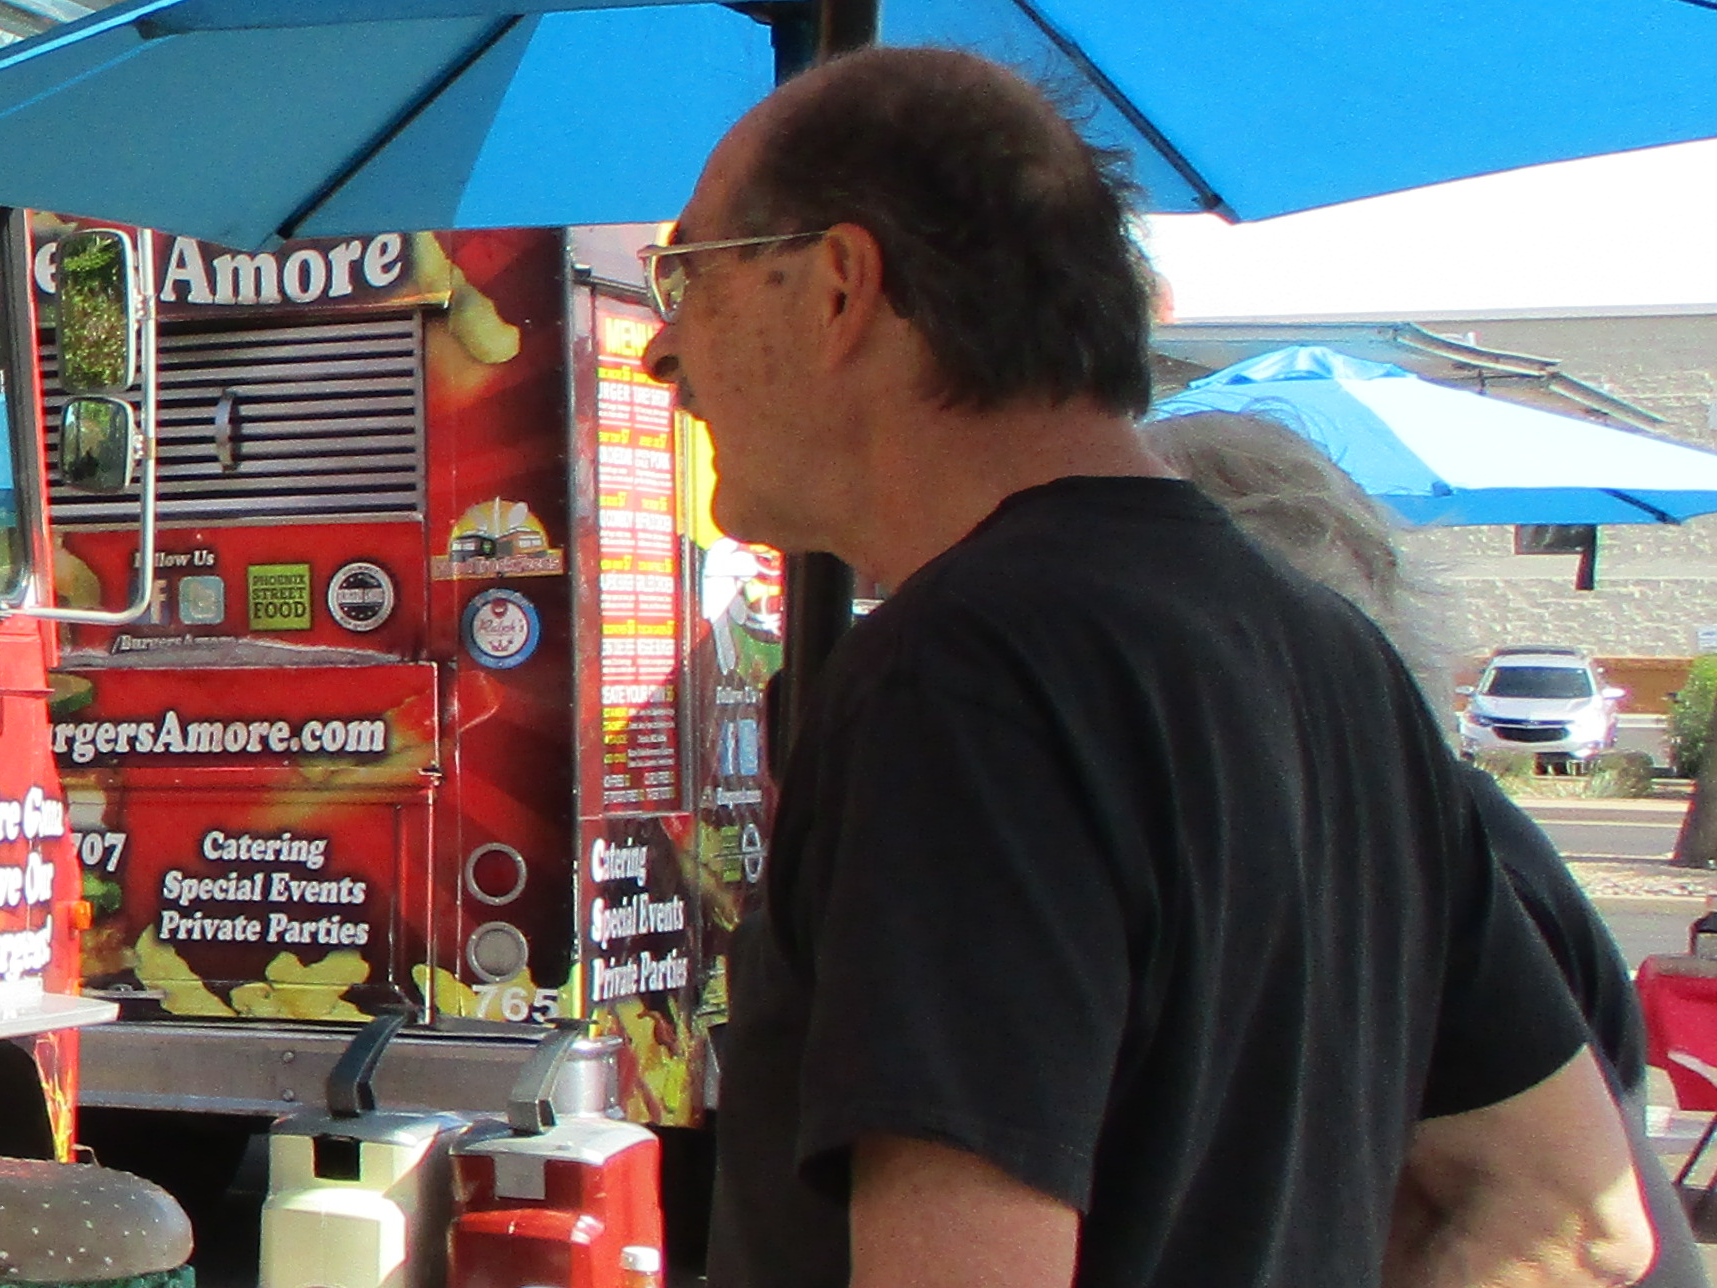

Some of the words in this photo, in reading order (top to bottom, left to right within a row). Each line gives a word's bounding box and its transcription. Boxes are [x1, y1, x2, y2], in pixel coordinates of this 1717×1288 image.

[160, 232, 403, 306] Amore
[193, 551, 215, 567] Us
[252, 574, 306, 586] PHOENIX
[252, 588, 306, 600] STREET
[252, 601, 306, 620] FOOD
[52, 711, 387, 764] rgersAmore.com
[203, 832, 327, 870] Catering
[591, 837, 648, 888] Catering
[163, 871, 263, 907] Special
[268, 873, 367, 905] Events
[159, 911, 262, 942] Private
[267, 913, 369, 946] Parties
[590, 897, 638, 949] Special
[639, 892, 685, 934] Events
[591, 958, 638, 1002] Private
[639, 950, 688, 993] Parties
[472, 984, 559, 1022] 765
